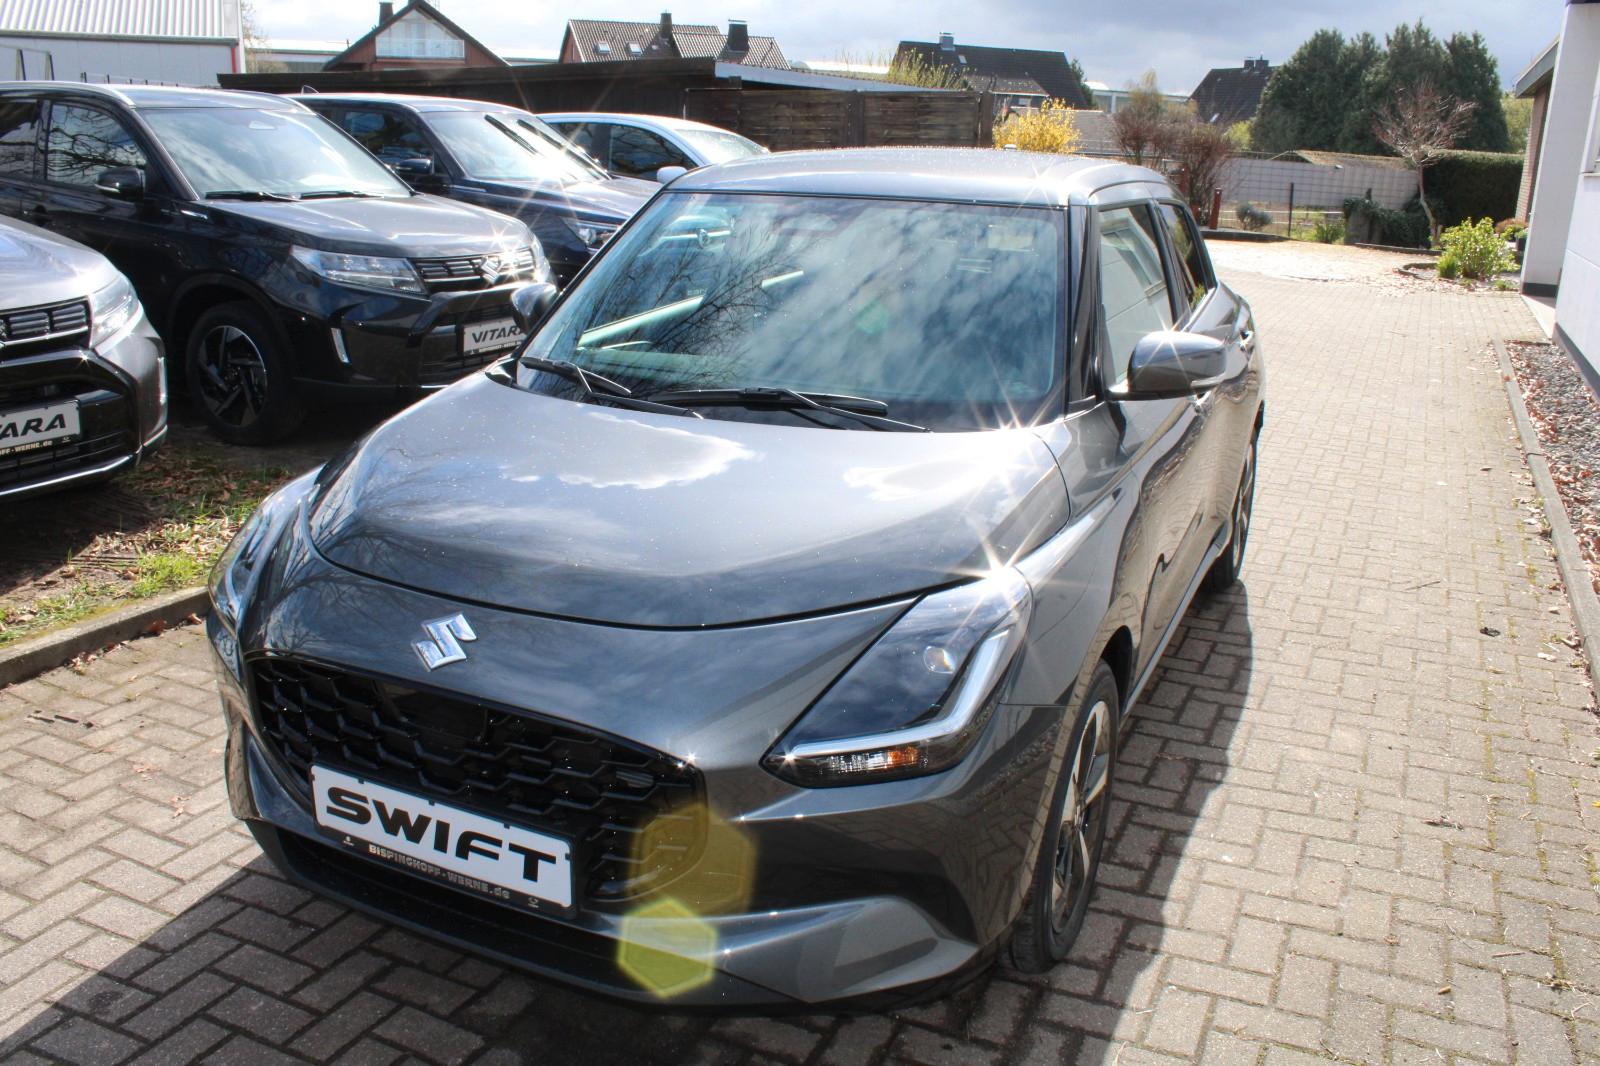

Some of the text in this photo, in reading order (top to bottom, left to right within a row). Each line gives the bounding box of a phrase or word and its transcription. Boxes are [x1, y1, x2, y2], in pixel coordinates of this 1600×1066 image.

[472, 326, 520, 343] VITAR
[0, 414, 66, 440] ARA
[326, 786, 556, 882] SWIFT
